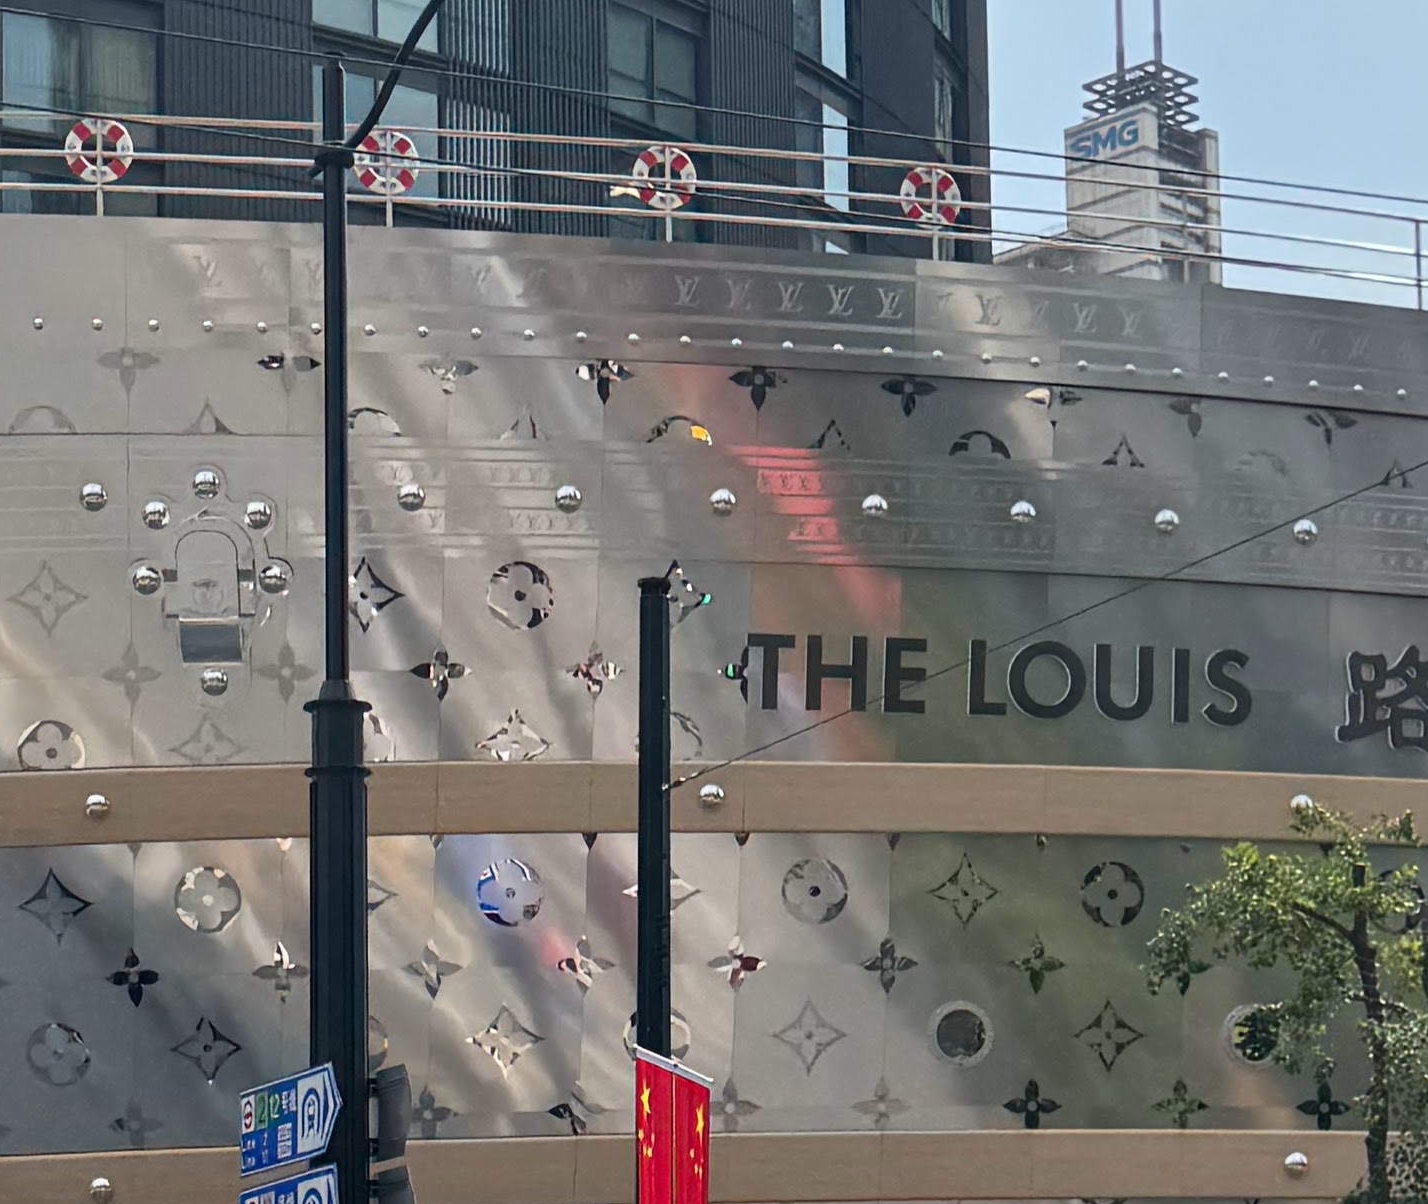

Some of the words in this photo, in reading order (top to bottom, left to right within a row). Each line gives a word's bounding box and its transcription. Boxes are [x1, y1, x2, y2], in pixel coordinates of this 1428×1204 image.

[1069, 120, 1139, 159] SMG
[746, 633, 927, 713] THE
[967, 639, 1252, 727] LOUIS
